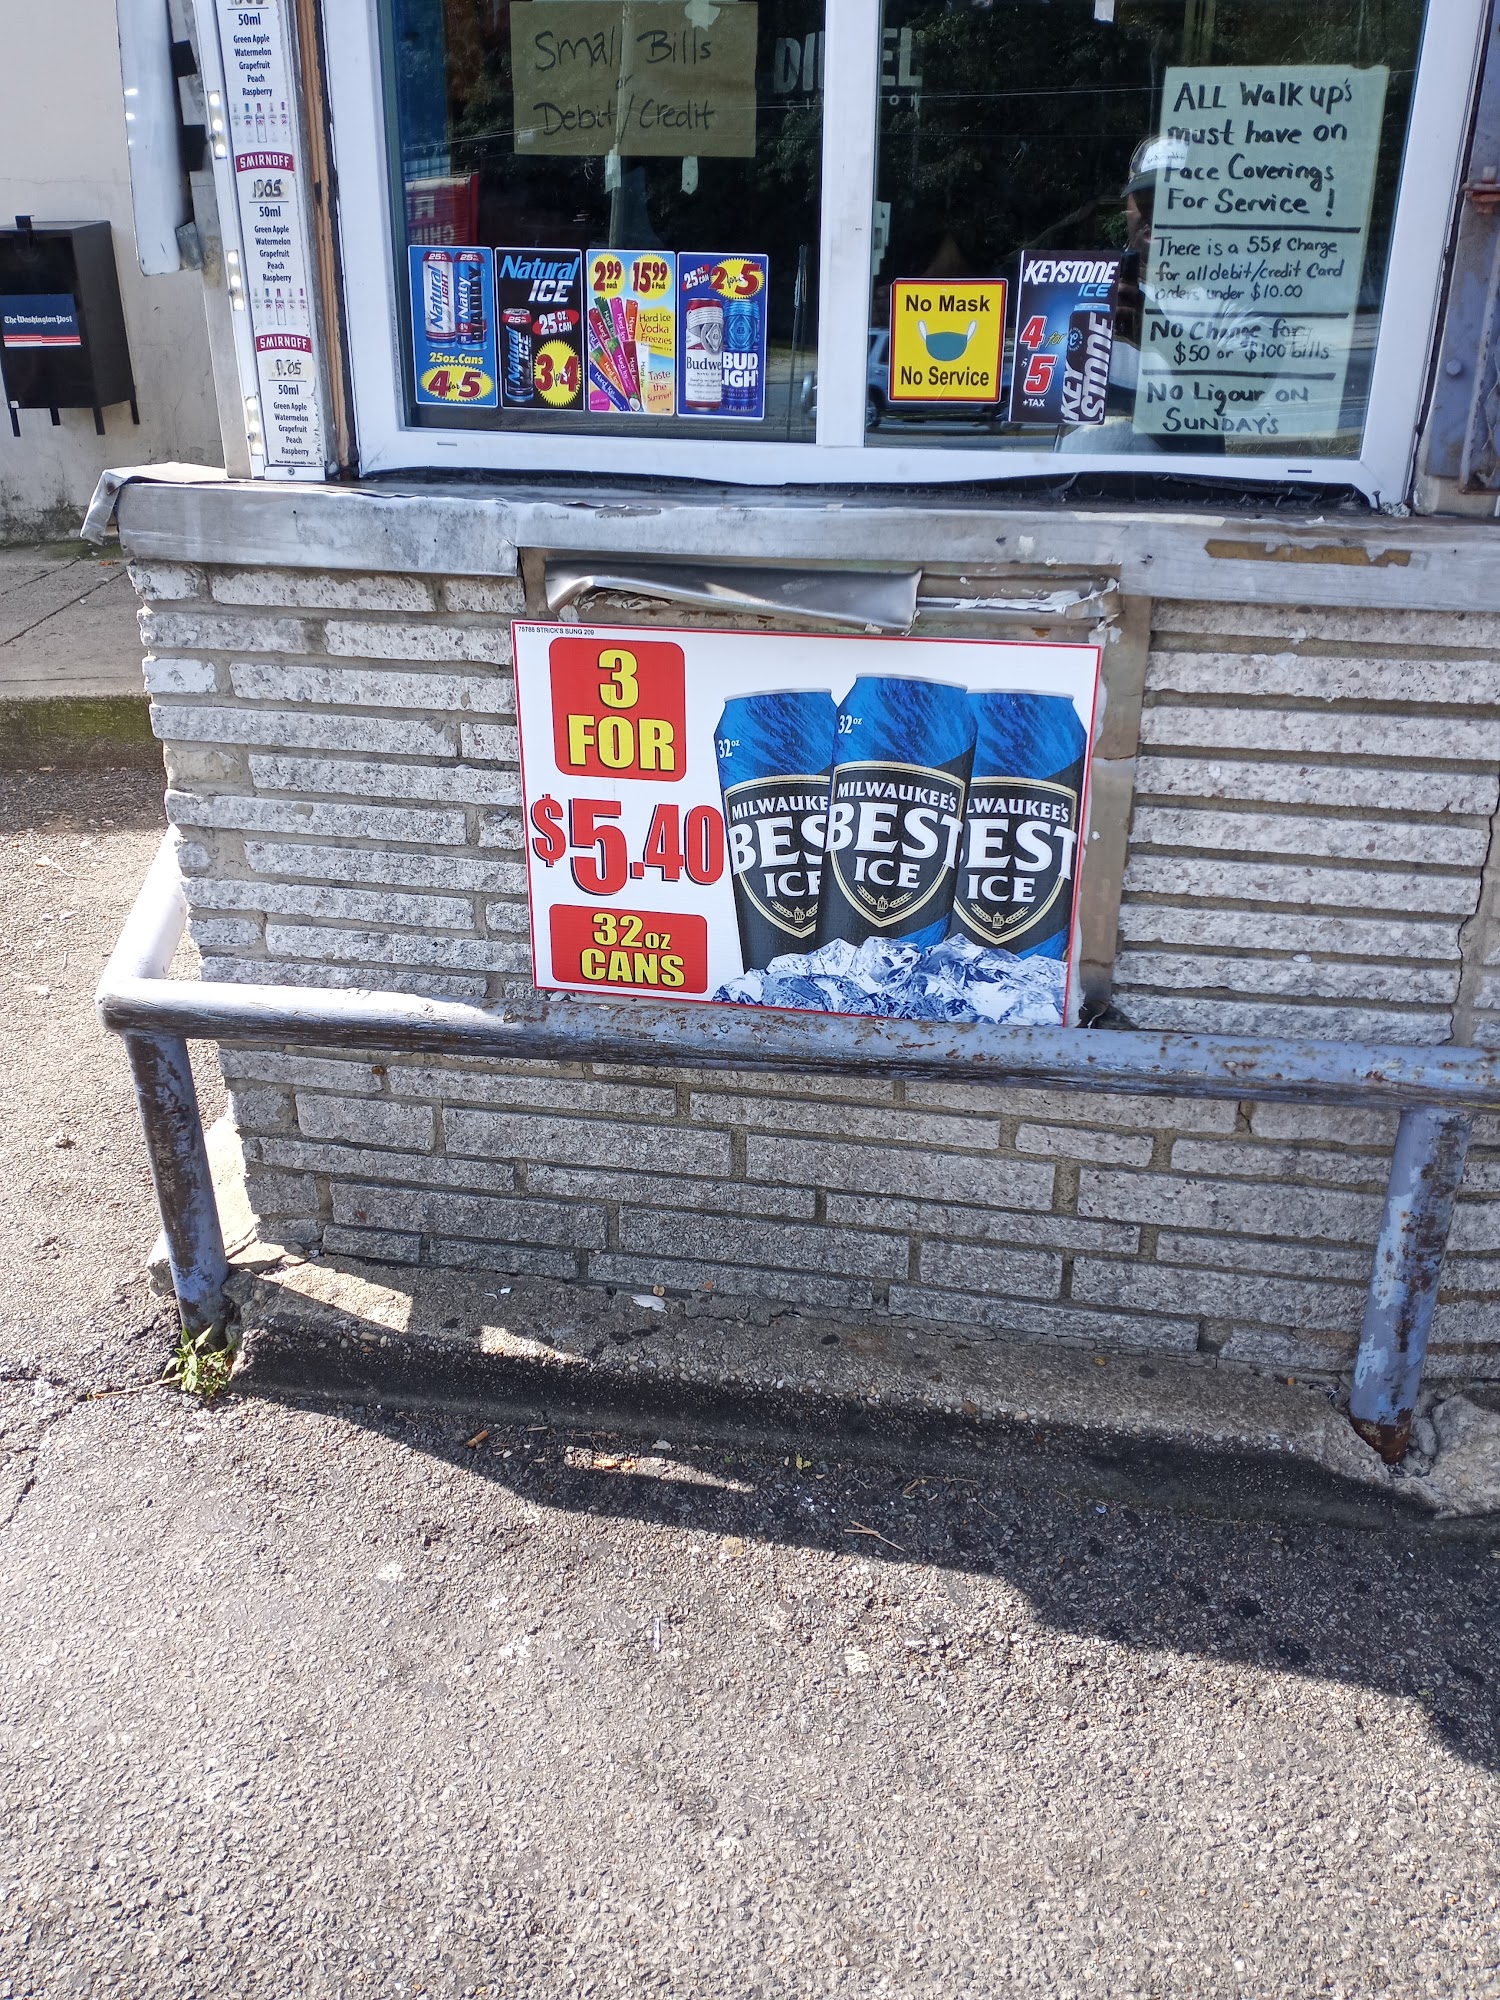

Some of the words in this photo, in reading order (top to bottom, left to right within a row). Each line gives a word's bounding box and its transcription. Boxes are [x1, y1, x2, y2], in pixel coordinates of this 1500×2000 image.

[238, 12, 261, 26] 50ml
[233, 35, 252, 43] Green
[252, 34, 270, 44] Apple
[535, 25, 623, 71] Small
[636, 29, 712, 65] Bills
[234, 47, 272, 57] Watermelon
[238, 60, 271, 71] Grapefruit
[247, 74, 265, 83] Peach
[615, 74, 634, 90] or
[242, 87, 273, 97] Raspberry
[1173, 82, 1227, 112] ALL
[1167, 118, 1235, 146] must
[1245, 119, 1302, 144] have
[1313, 123, 1348, 141] on
[240, 155, 289, 168] SMIRNOFF
[1164, 160, 1219, 183] Face
[1228, 153, 1334, 192] Coverings
[1167, 188, 1208, 209] For
[1214, 188, 1310, 214] Service
[259, 206, 281, 218] 50ml
[254, 225, 272, 233] Green
[272, 225, 289, 234] Apple
[255, 237, 291, 245] Watermelon
[1154, 236, 1201, 256] There
[1208, 239, 1223, 256] is
[1228, 243, 1239, 254] a
[259, 249, 290, 259] Grapefruit
[267, 261, 285, 270] Peach
[500, 255, 580, 280] Natural
[1023, 259, 1120, 285] KEYSTONE
[1156, 261, 1180, 282] for
[262, 274, 292, 283] Raspberry
[606, 281, 618, 289] each
[683, 270, 699, 289] 25
[698, 273, 709, 284] CAN
[708, 266, 727, 290] 2
[427, 264, 444, 331] Natural
[441, 273, 449, 307] LIGHT
[458, 276, 471, 320] Natty
[528, 280, 574, 303] ICE
[1078, 283, 1111, 297] ICE
[1155, 285, 1200, 301] orders
[1206, 285, 1245, 301] under
[1250, 283, 1303, 301] $10.00
[906, 294, 932, 312] No
[938, 294, 991, 312] Mask
[4, 315, 17, 325] The
[16, 314, 57, 325] Washington
[56, 314, 73, 325] Post
[538, 312, 558, 335] 25
[558, 321, 572, 333] CAN
[640, 313, 659, 322] Hard
[660, 313, 671, 322] Ice
[640, 322, 669, 334] Vodka
[1019, 315, 1048, 350] 4
[1045, 331, 1067, 348] for
[1189, 322, 1261, 342] Change
[1269, 318, 1301, 338] for
[260, 336, 307, 349] SMIRNOFF
[518, 332, 529, 361] ICE
[641, 333, 672, 345] Freezies
[505, 324, 521, 386] Natural
[722, 351, 759, 370] BUD
[1174, 341, 1210, 366] $50
[1216, 349, 1234, 360] or
[1244, 341, 1286, 363] $100
[1291, 341, 1330, 360] bills
[533, 353, 555, 391] 3
[648, 370, 671, 380] Taste
[900, 366, 923, 386] No
[928, 365, 990, 387] Service
[278, 384, 299, 395] 50ml
[427, 370, 450, 397] 4
[653, 383, 667, 391] the
[1060, 359, 1084, 421] KEY
[273, 402, 290, 410] Green
[291, 403, 307, 412] Apple
[274, 413, 309, 422] Watermelon
[278, 425, 307, 433] Grapefruit
[285, 436, 302, 444] Peach
[281, 446, 309, 456] Raspberry
[598, 648, 639, 709] 3
[567, 713, 676, 772] FOR
[837, 781, 957, 812] MILWAUKEE'S
[825, 801, 963, 869] BEST
[531, 793, 725, 897] $5.40
[959, 818, 1078, 880] EST
[854, 857, 921, 889] ICE
[967, 874, 1037, 903] ICE
[580, 948, 686, 987] CANS
